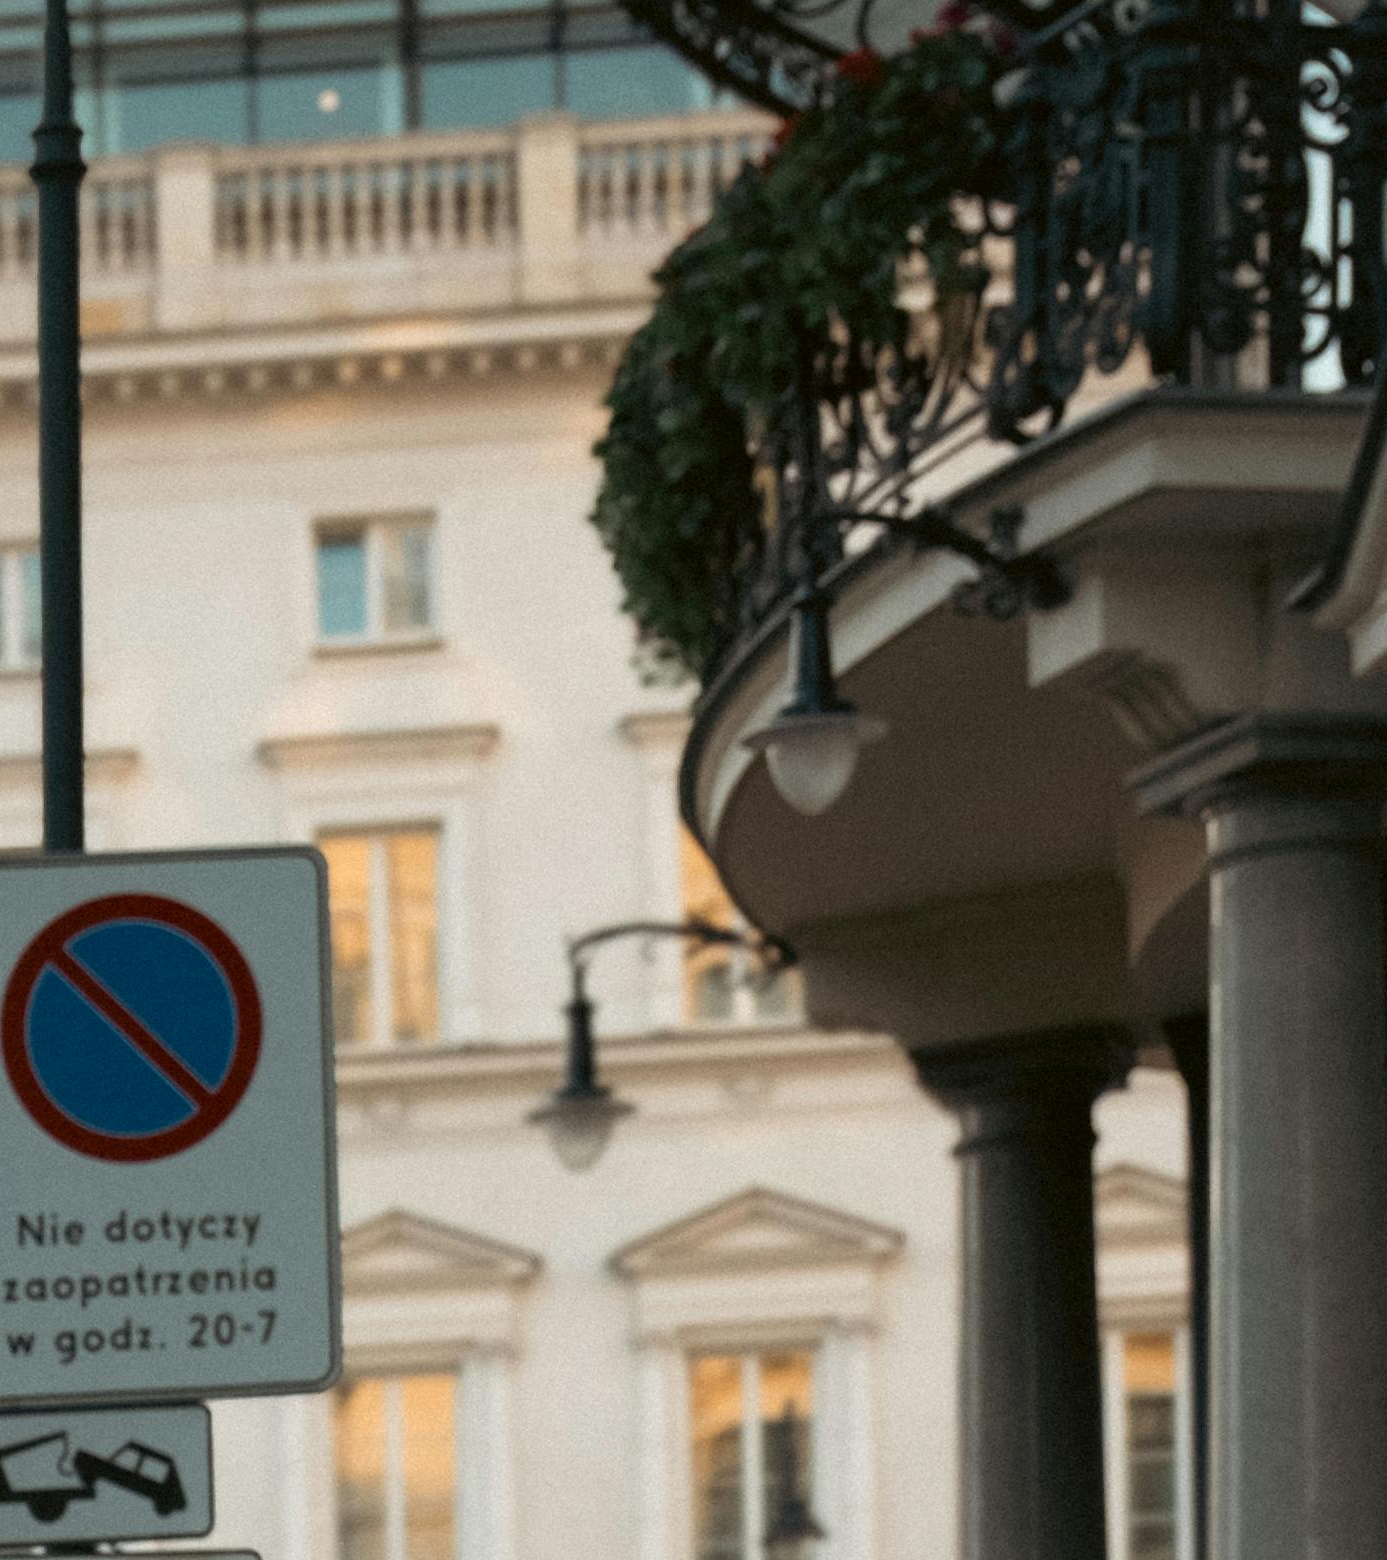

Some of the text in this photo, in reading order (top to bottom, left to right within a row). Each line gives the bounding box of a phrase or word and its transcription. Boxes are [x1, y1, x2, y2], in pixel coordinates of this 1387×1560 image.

[17, 1210, 261, 1249] Nie dotyczy
[2, 1258, 277, 1308] zaopatrzenia
[7, 1310, 277, 1365] w godz. 20-7
